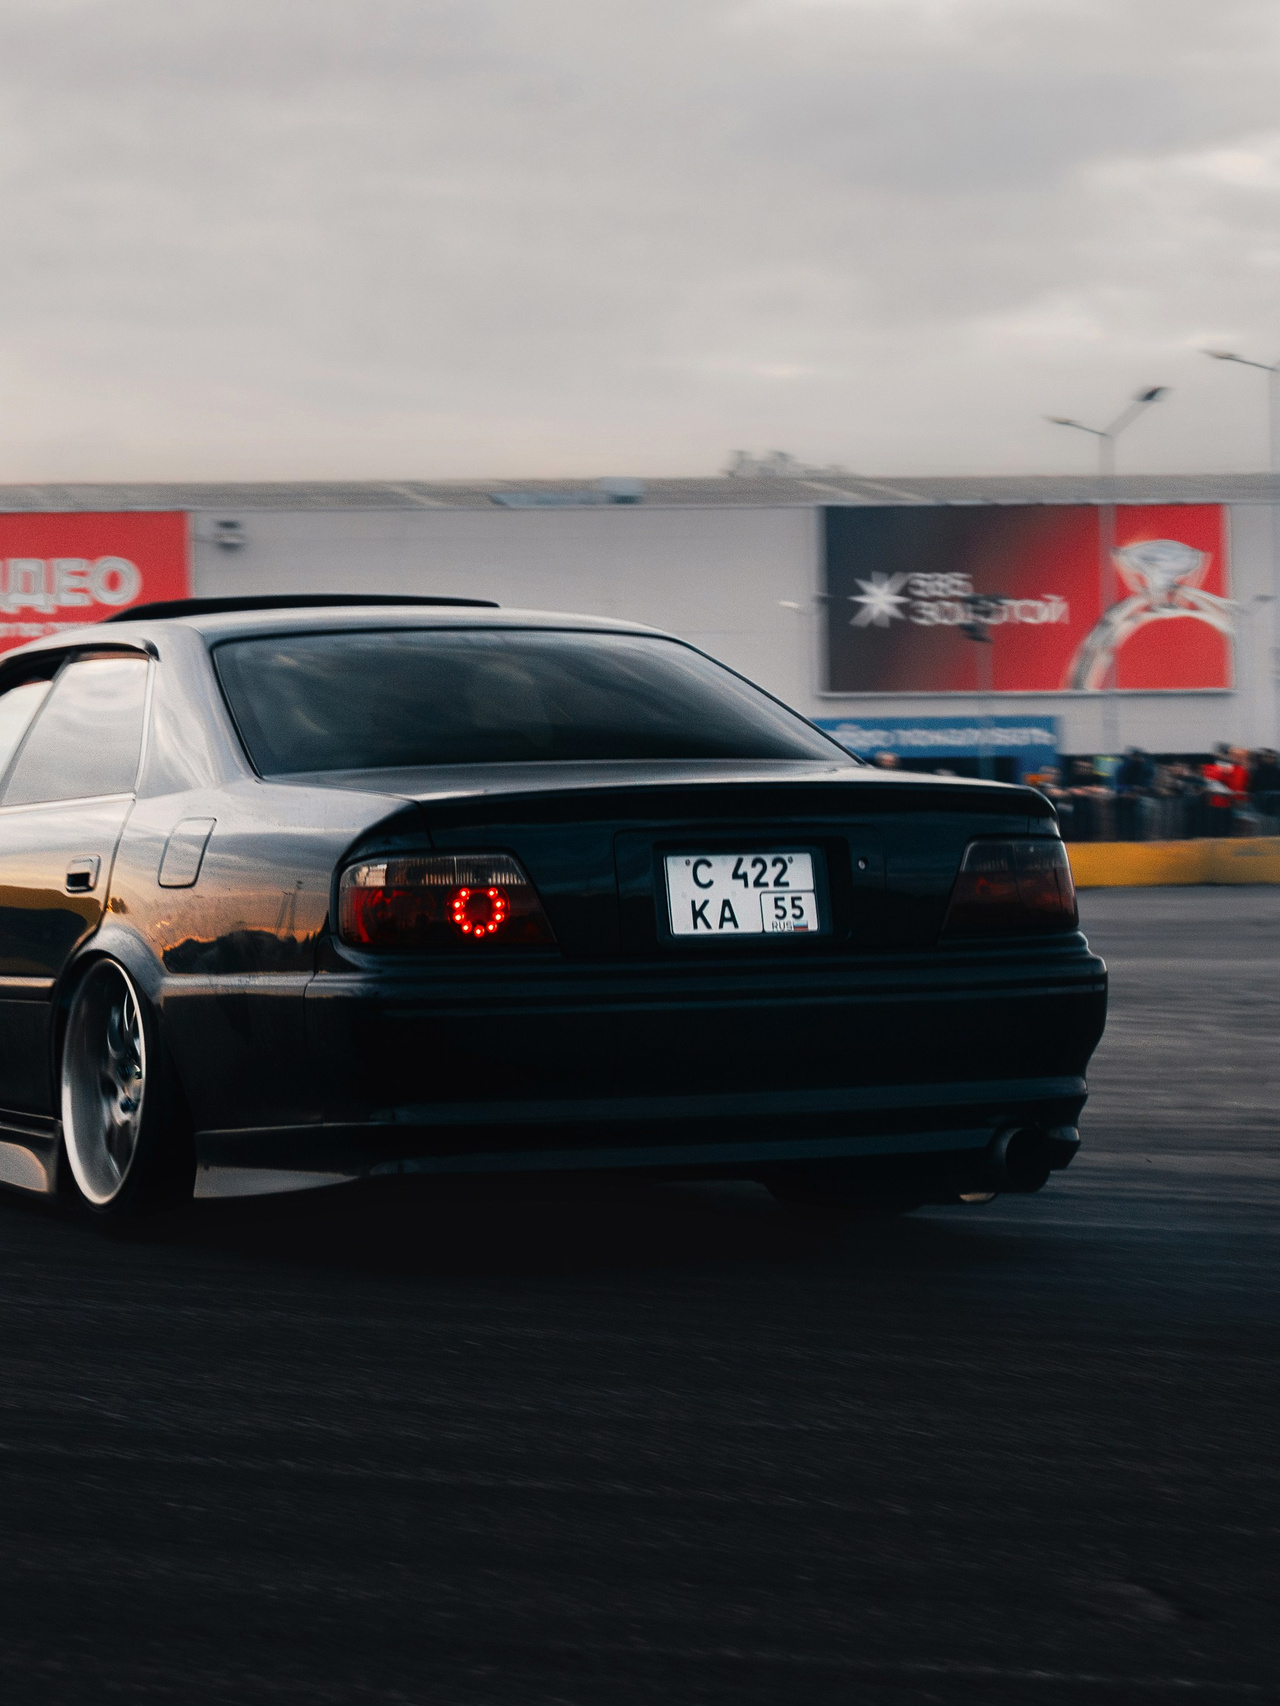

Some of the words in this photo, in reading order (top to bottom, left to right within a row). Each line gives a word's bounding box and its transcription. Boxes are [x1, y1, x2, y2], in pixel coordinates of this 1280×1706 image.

[692, 858, 714, 889] C
[731, 857, 790, 888] 422
[691, 898, 739, 930] KA
[773, 896, 805, 920] 55
[771, 920, 793, 932] RUS
